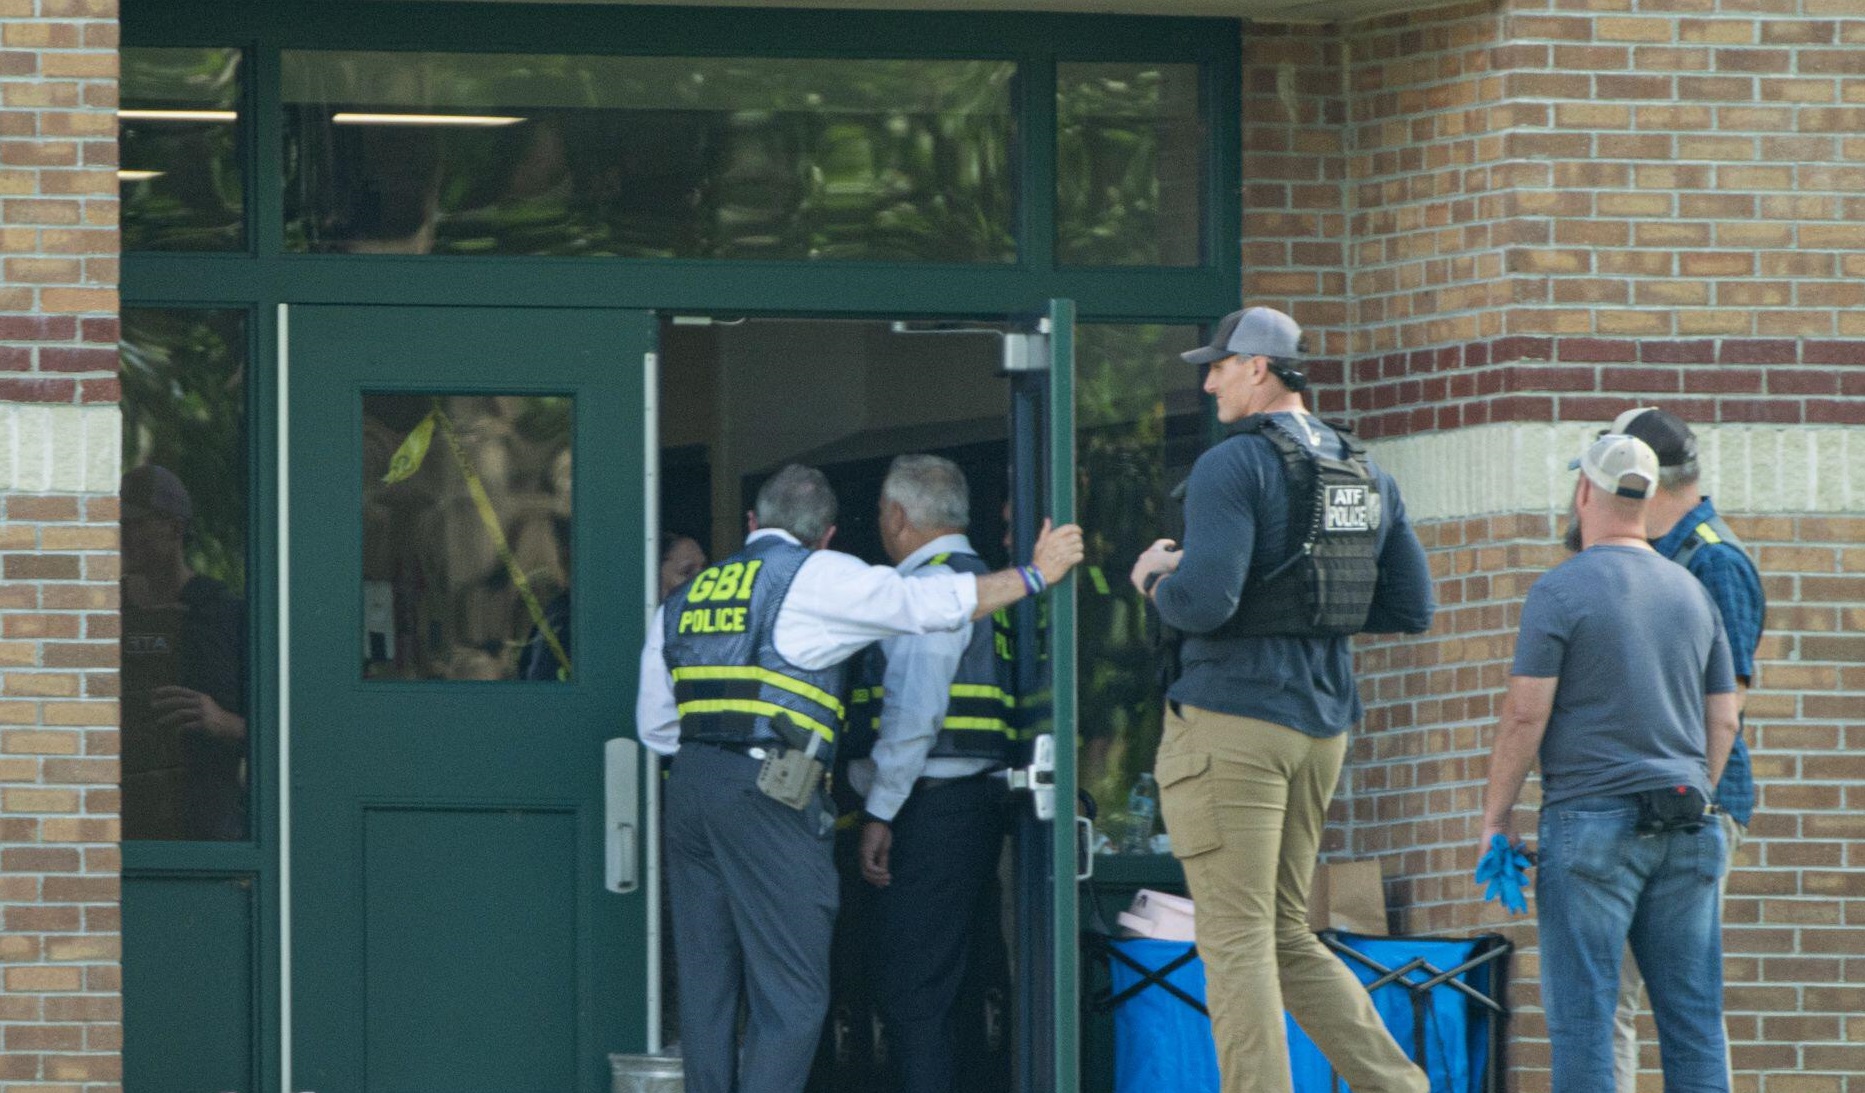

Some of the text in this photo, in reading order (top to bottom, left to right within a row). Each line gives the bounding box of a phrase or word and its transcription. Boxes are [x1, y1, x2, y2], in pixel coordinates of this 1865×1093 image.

[1333, 488, 1363, 505] ATF
[1328, 505, 1367, 527] POLICE
[687, 559, 763, 603] GBI
[678, 606, 748, 634] POLICE
